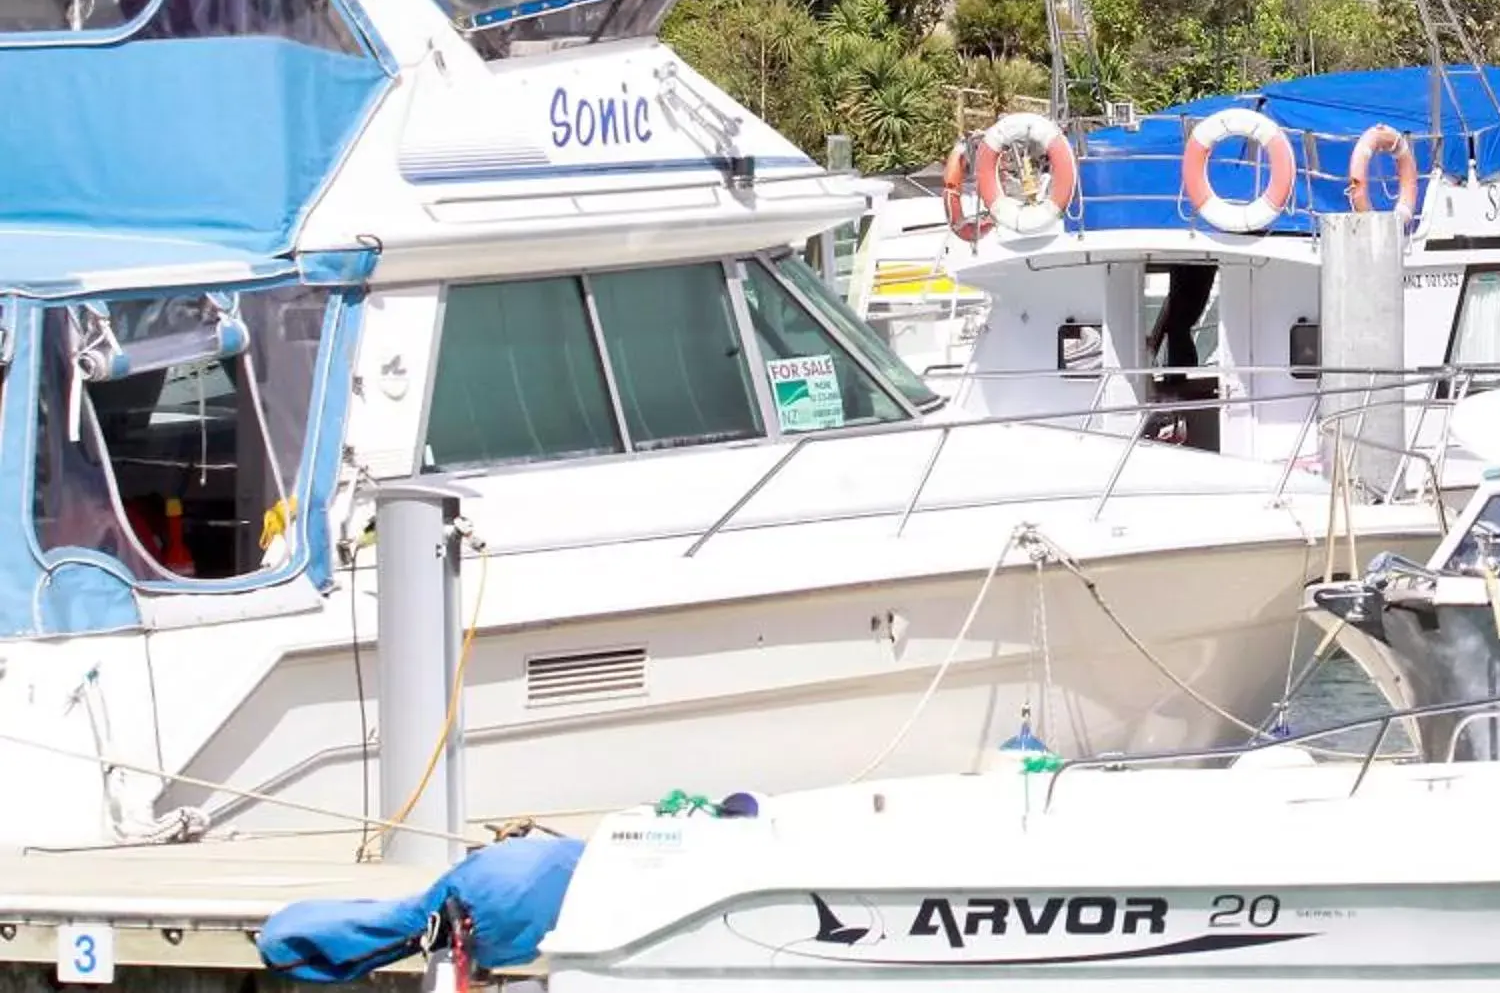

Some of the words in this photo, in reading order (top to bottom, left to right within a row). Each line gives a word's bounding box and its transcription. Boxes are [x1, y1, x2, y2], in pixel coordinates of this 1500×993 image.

[549, 81, 652, 148] Sonic
[770, 362, 799, 381] FOR
[801, 358, 834, 378] SALE
[909, 896, 1168, 948] ARVOR
[1207, 894, 1281, 928] 20
[75, 934, 97, 974] 3
